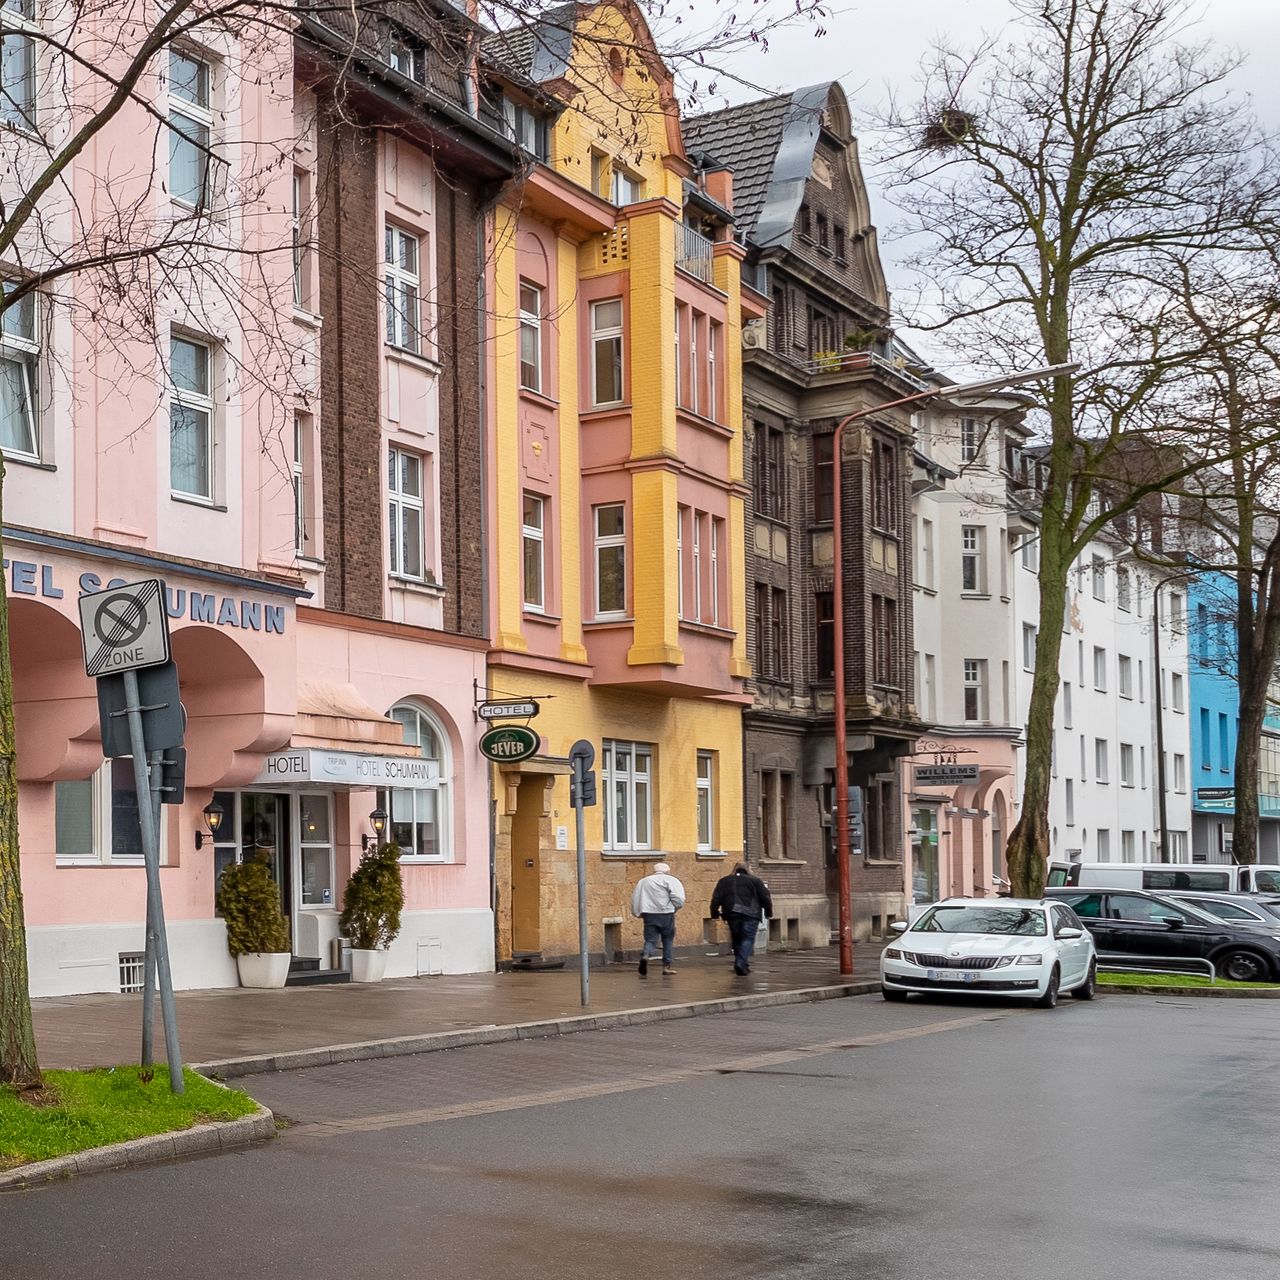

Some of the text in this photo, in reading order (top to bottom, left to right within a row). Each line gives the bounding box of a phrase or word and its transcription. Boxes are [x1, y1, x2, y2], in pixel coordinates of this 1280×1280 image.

[104, 647, 145, 668] ZONE
[482, 706, 532, 715] HOTEL
[490, 742, 524, 756] JEVER
[267, 756, 308, 773] HOTEL
[356, 761, 381, 776] HOTEL
[385, 762, 430, 780] SCHUMANN
[916, 767, 977, 776] WILLEMS
